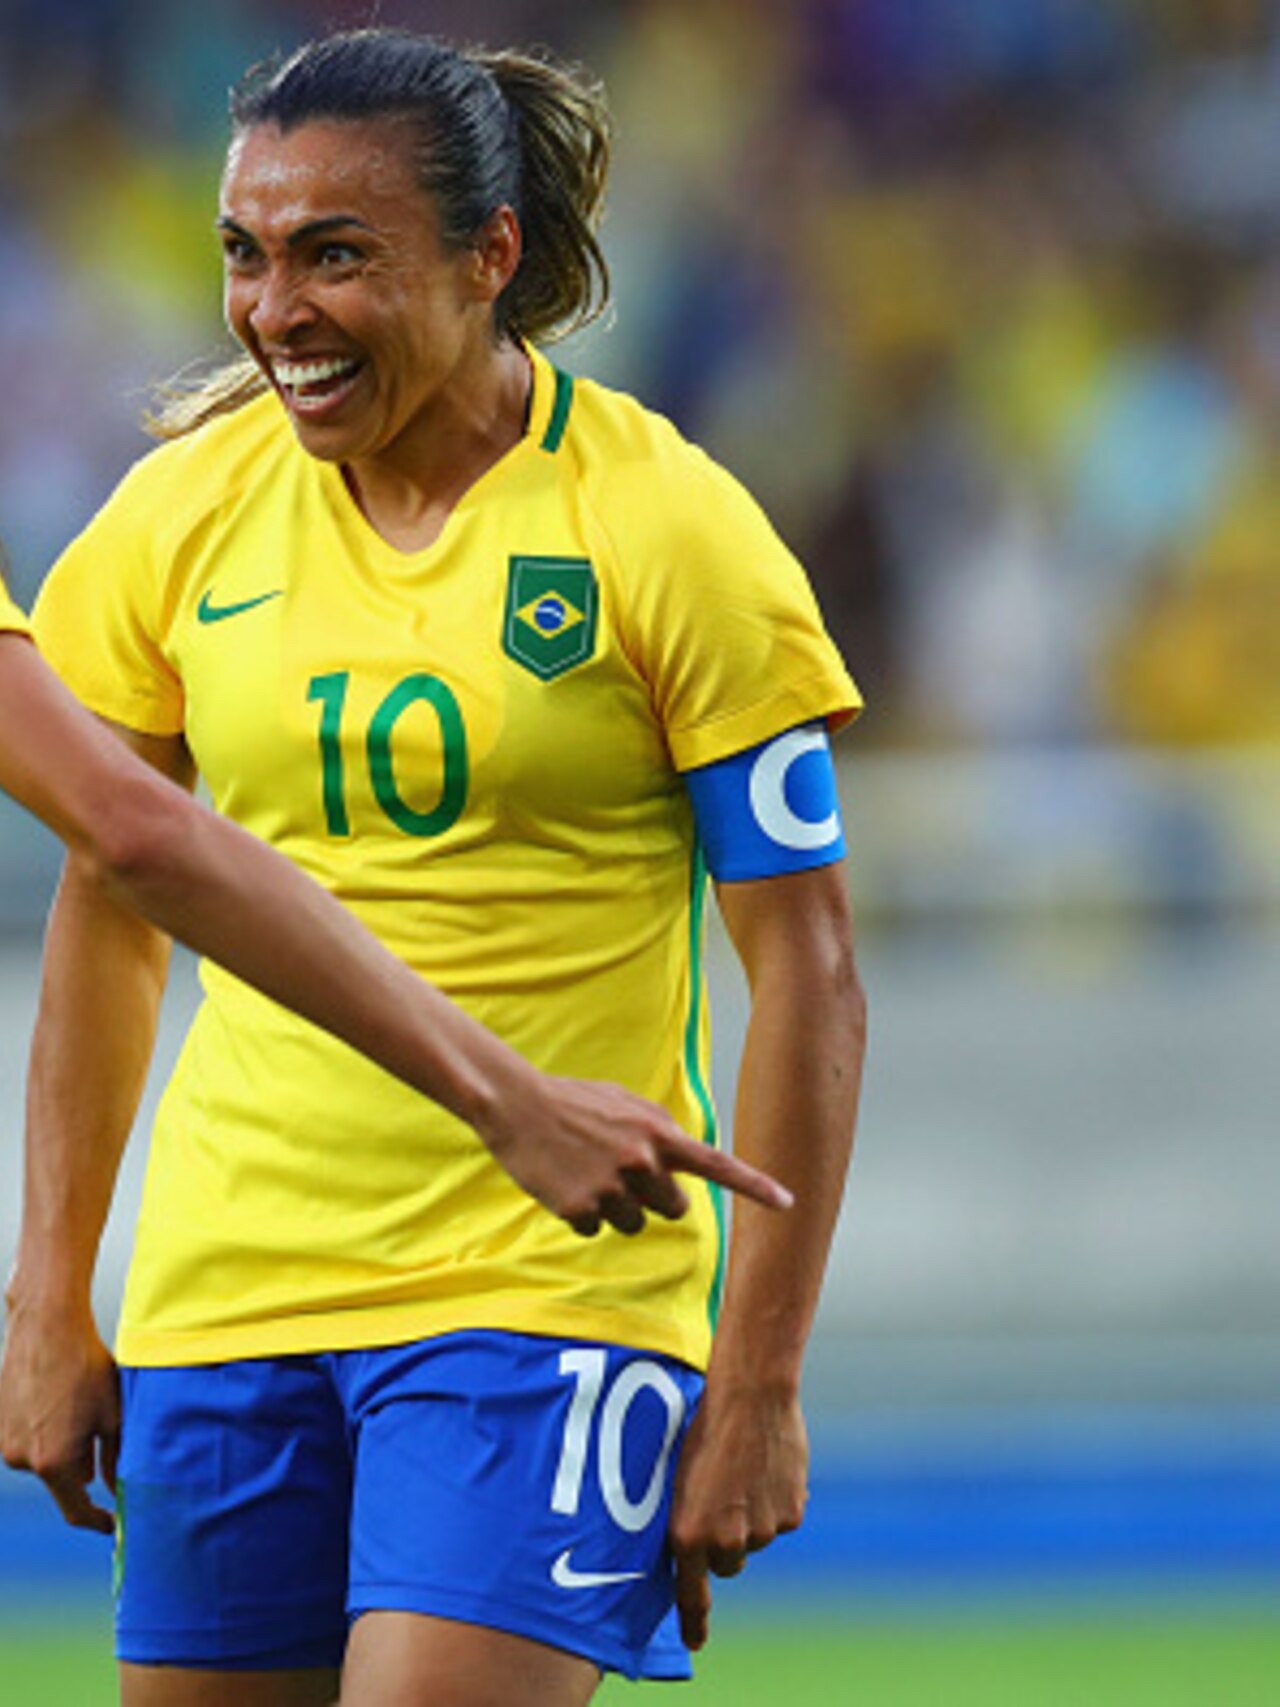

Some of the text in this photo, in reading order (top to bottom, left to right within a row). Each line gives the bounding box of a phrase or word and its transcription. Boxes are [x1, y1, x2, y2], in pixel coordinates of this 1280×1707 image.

[306, 670, 470, 838] 10
[749, 726, 840, 850] C
[550, 1348, 686, 1532] 10
